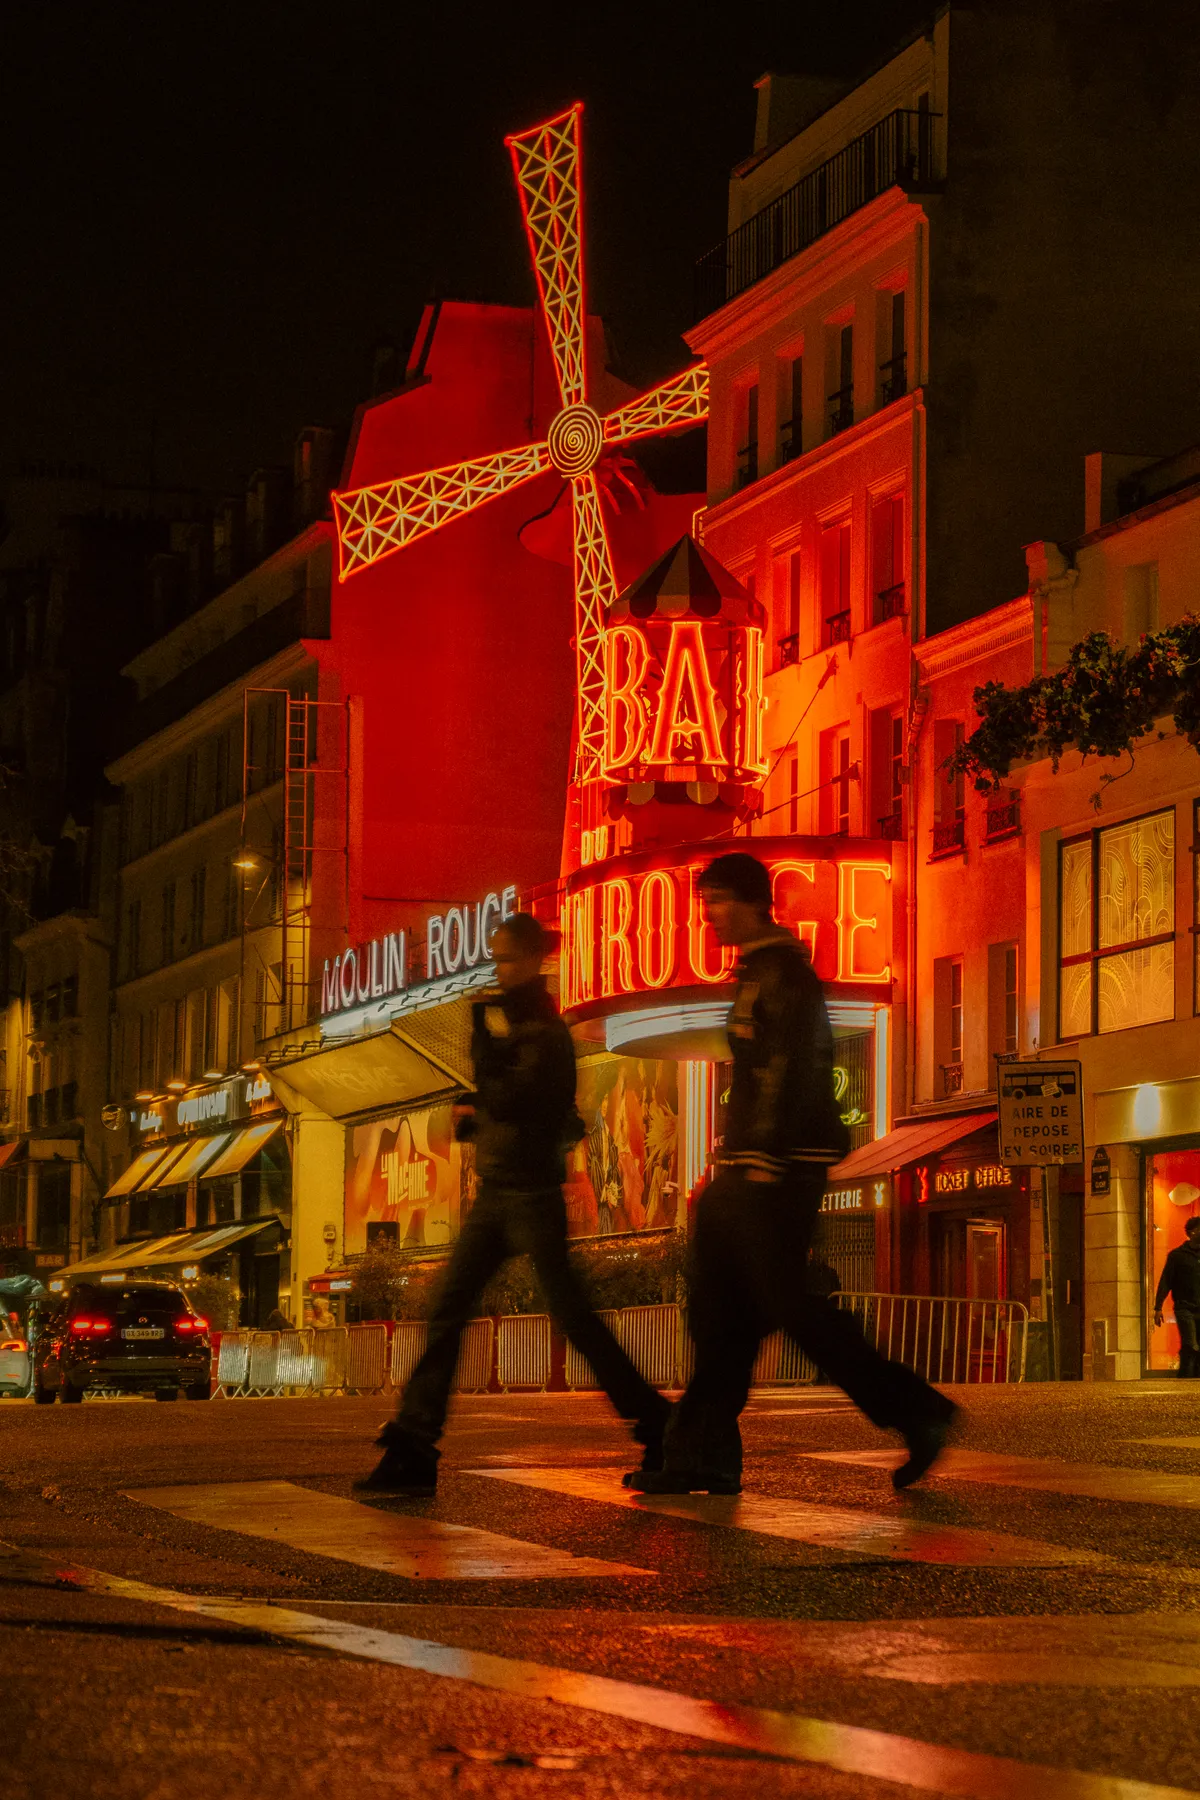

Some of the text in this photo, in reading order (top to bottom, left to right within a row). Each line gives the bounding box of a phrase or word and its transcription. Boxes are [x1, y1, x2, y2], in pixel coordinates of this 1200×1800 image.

[321, 929, 406, 1014] MOULIN
[1013, 1105, 1068, 1119] AIRE DE
[1004, 1146, 1021, 1157] EN
[976, 1164, 1012, 1188] OFFICE
[818, 1189, 861, 1212] ETTERIE
